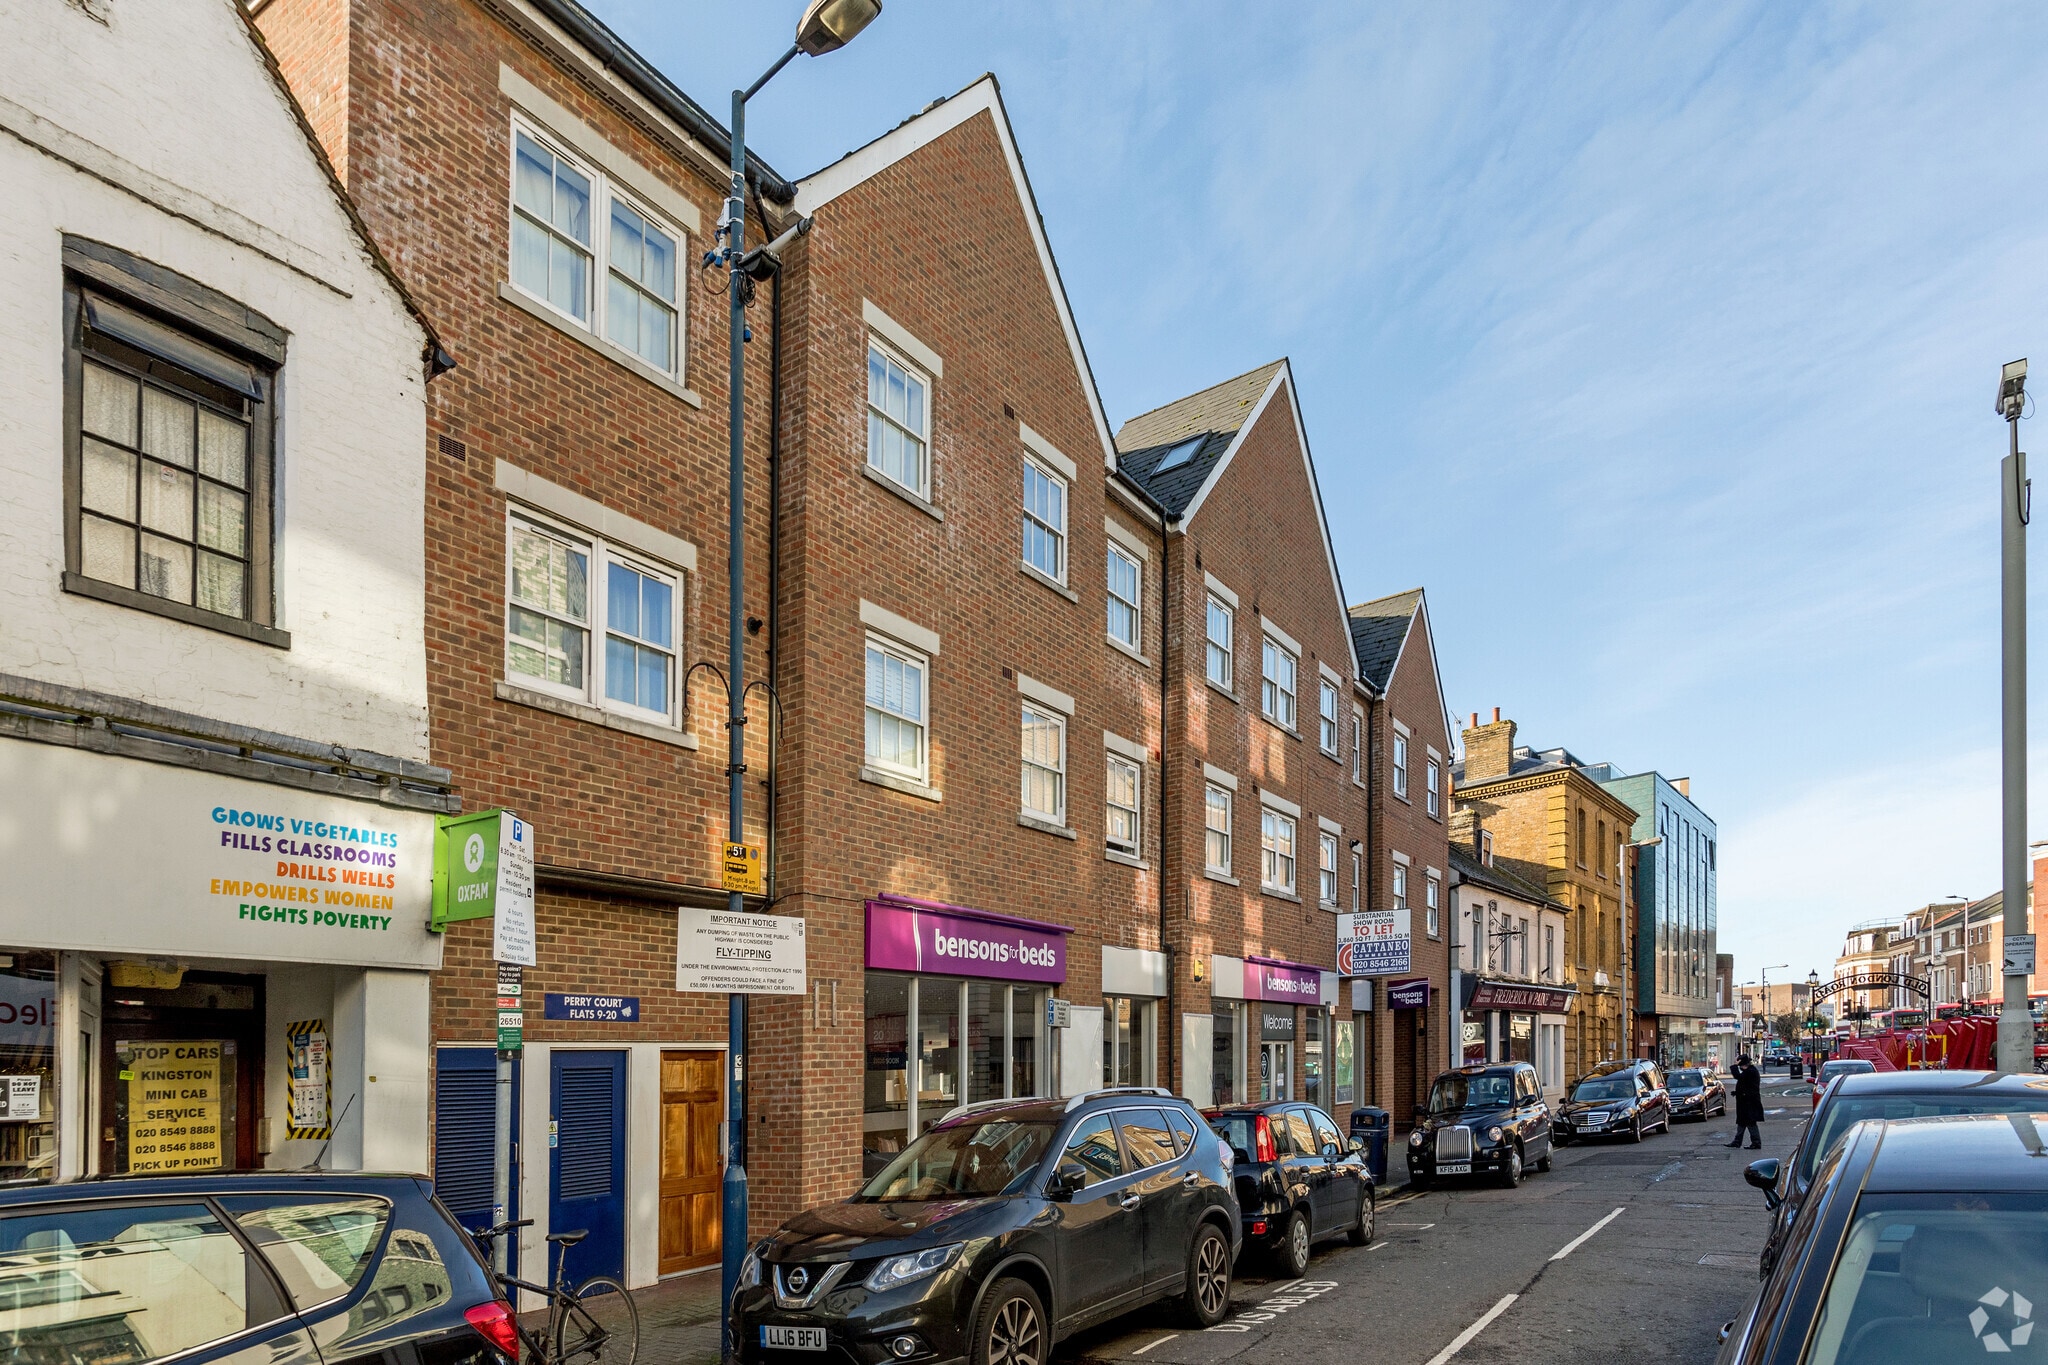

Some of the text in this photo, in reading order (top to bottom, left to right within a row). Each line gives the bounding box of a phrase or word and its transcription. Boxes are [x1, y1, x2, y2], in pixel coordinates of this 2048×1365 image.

[212, 807, 397, 848] GROWS VEGETABLES
[515, 824, 520, 838] P
[222, 831, 396, 868] FILLS CLASSROOMS
[733, 846, 743, 856] 5T
[510, 860, 523, 872] Sunday
[277, 862, 394, 888] DRILLS WELLS
[506, 878, 521, 889] Resident
[210, 878, 393, 910] EMPOWERS WOMEN
[458, 882, 488, 902] OXFAM
[240, 904, 392, 930] FIGHTS POVERTY
[512, 909, 523, 917] hours
[1353, 912, 1394, 920] SUBSTANTIAL
[710, 915, 777, 928] IMPORTANT NOTICE
[1353, 924, 1394, 936] TO LET
[716, 947, 771, 959] FLY-TIPPING
[935, 928, 1056, 967] bensons for beds
[1354, 941, 1408, 953] CATTANEO
[500, 952, 516, 961] Display
[1354, 958, 1408, 968] 020 8546 2166
[1267, 973, 1296, 992] bensons
[1301, 978, 1316, 995] beds
[1393, 991, 1423, 999] bensons
[1493, 989, 1529, 1004] FREDERICK
[564, 996, 622, 1008] PERRY COURT
[570, 1010, 617, 1019] FLATS 9-20
[1264, 1014, 1292, 1029] Welcome
[135, 1047, 219, 1060] TOP CARS
[141, 1070, 212, 1080] KINGSTON
[146, 1089, 208, 1100] MINI CAB
[147, 1108, 205, 1120] SERVICE
[136, 1126, 215, 1137] 020 8549 8888
[135, 1142, 215, 1154] 020 8546 8888
[134, 1157, 218, 1170] PICK UP POINT
[1438, 1165, 1468, 1174] KF15 AXG
[1203, 1281, 1339, 1332] DISABLED
[770, 1328, 821, 1347] LL16 BFU
